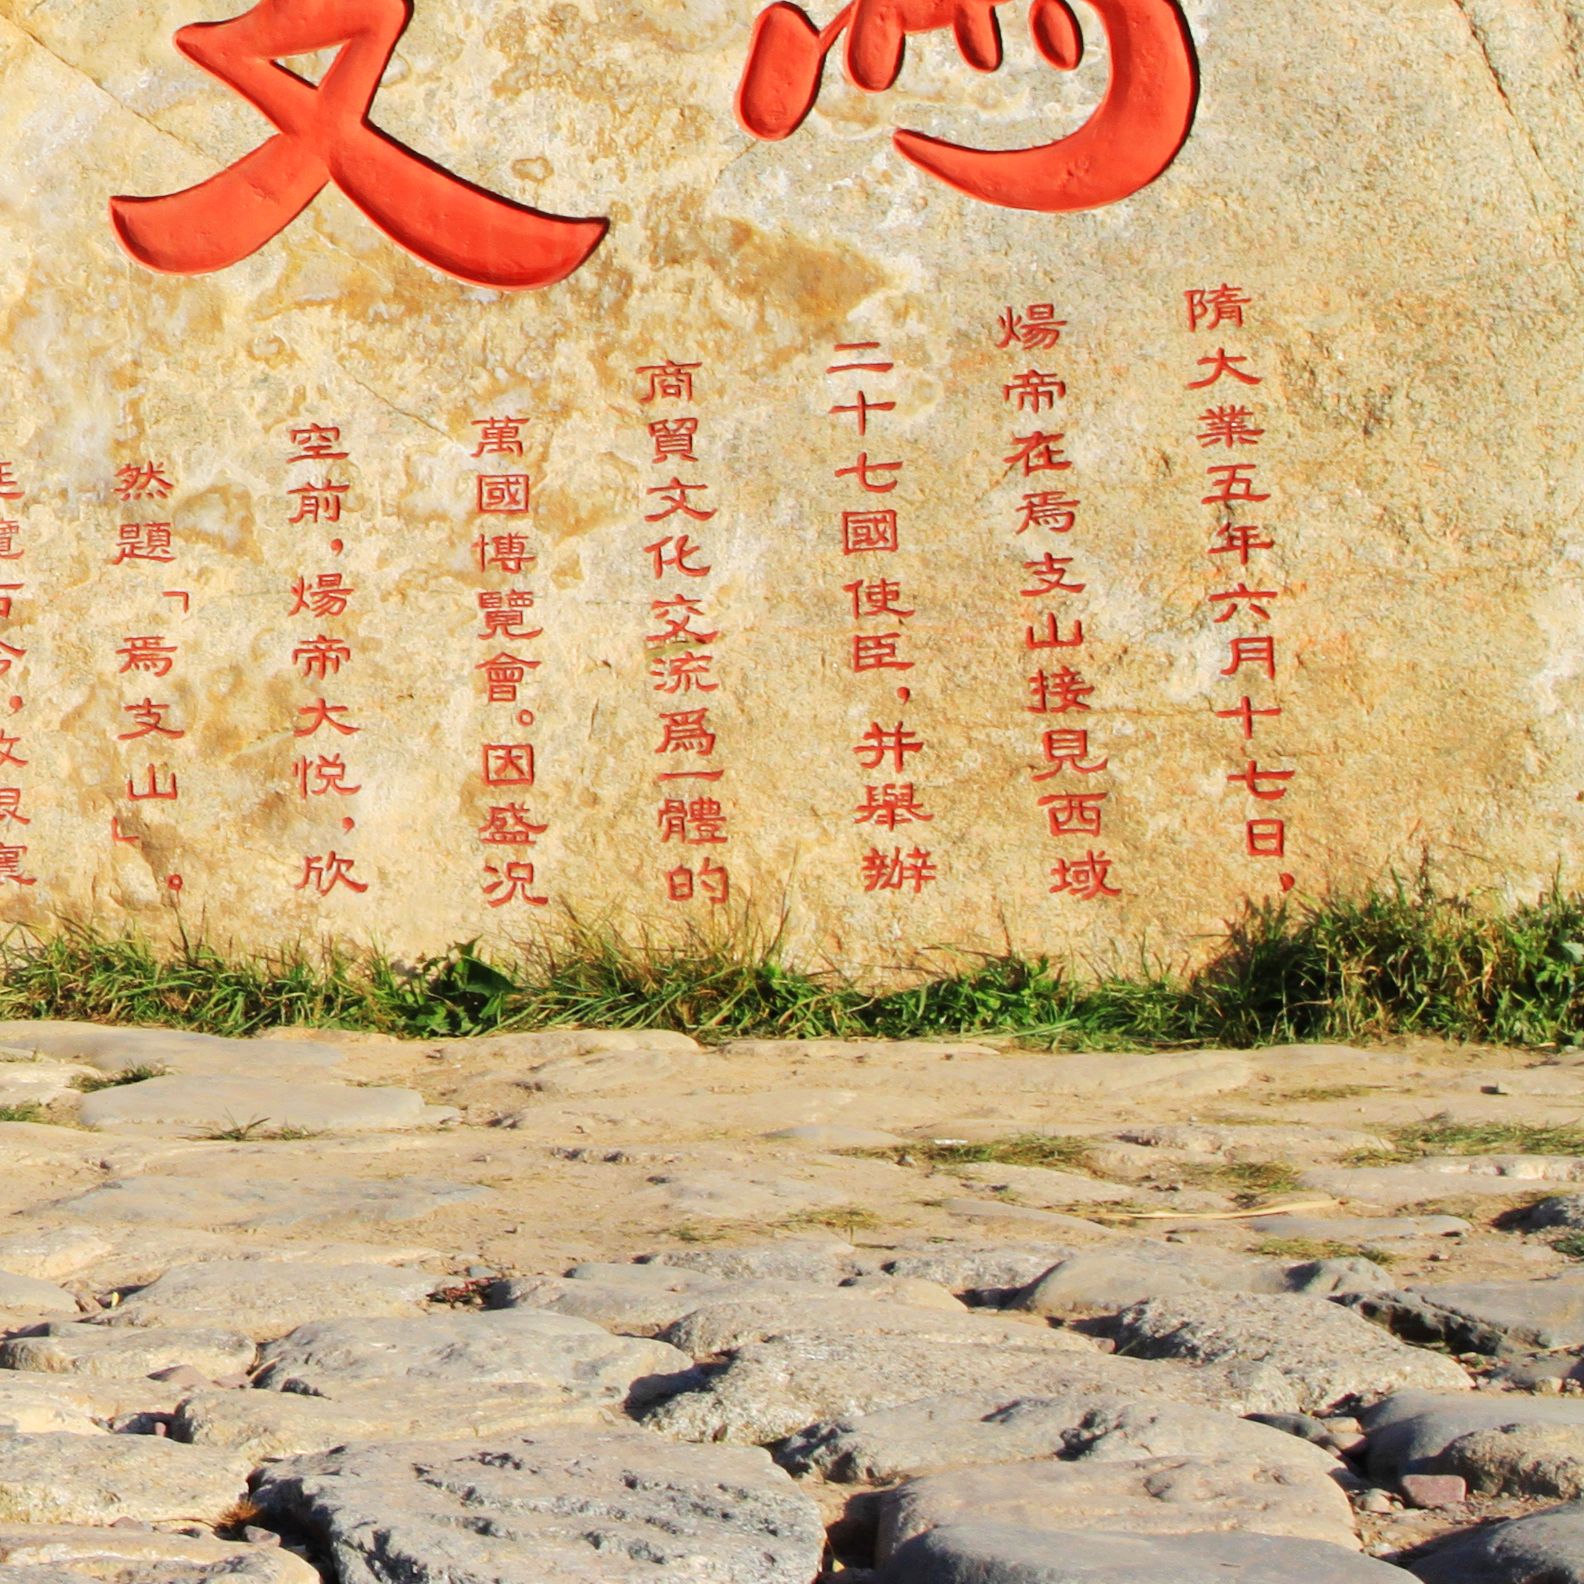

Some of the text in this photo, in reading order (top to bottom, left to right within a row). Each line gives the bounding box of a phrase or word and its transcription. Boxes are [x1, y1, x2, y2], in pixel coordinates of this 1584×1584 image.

[995, 302, 1122, 902] 煬帝在焉支山接見西域
